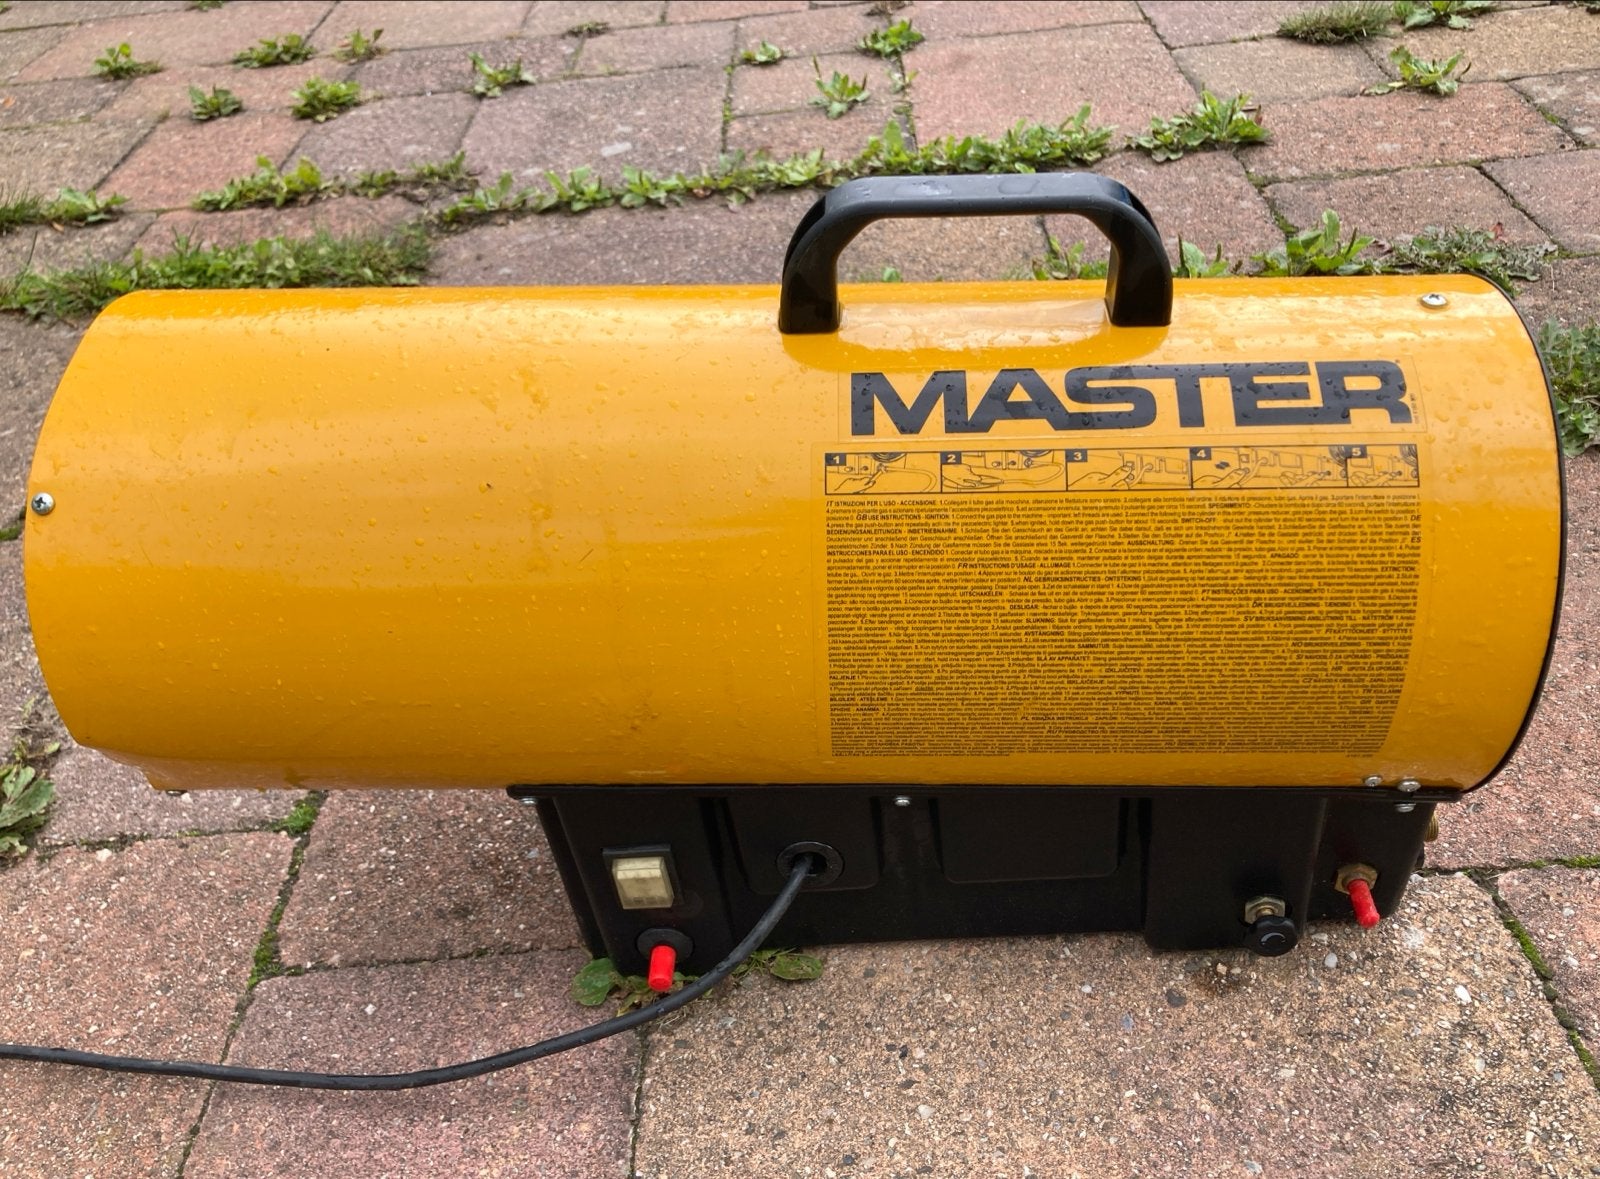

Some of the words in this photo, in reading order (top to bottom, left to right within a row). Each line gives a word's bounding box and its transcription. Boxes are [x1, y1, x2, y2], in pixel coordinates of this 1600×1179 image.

[851, 360, 1411, 435] MASTER
[1074, 452, 1082, 460] 3
[1196, 449, 1206, 458] 4
[1352, 448, 1362, 456] 5
